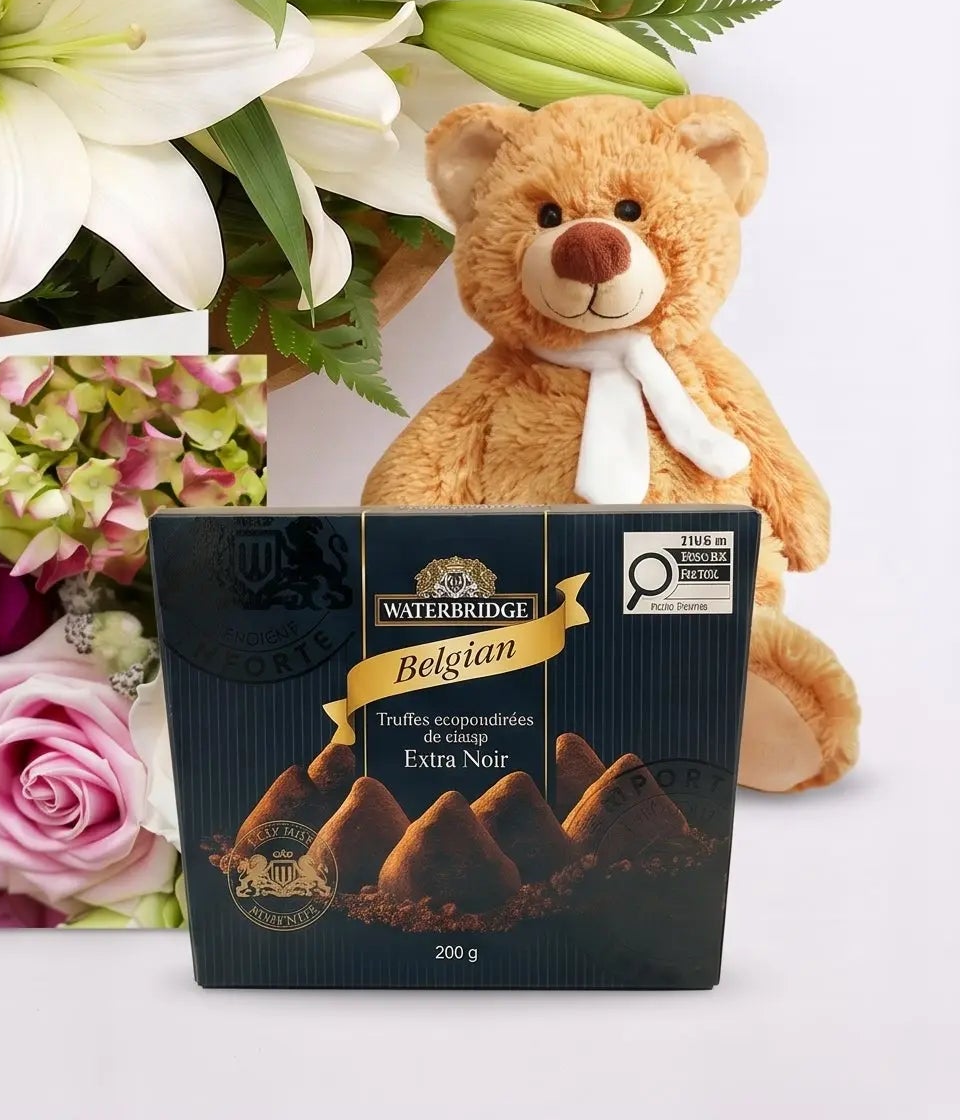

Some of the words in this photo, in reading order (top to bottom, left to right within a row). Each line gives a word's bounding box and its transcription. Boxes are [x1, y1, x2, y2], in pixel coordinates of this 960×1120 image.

[383, 602, 529, 619] WATERBRIDGE
[393, 639, 517, 685] Belgian
[376, 712, 430, 726] Truffes
[423, 729, 442, 743] de
[404, 749, 456, 768] Extra
[462, 749, 509, 768] Noir
[435, 945, 464, 960] 200
[468, 948, 478, 963] g
